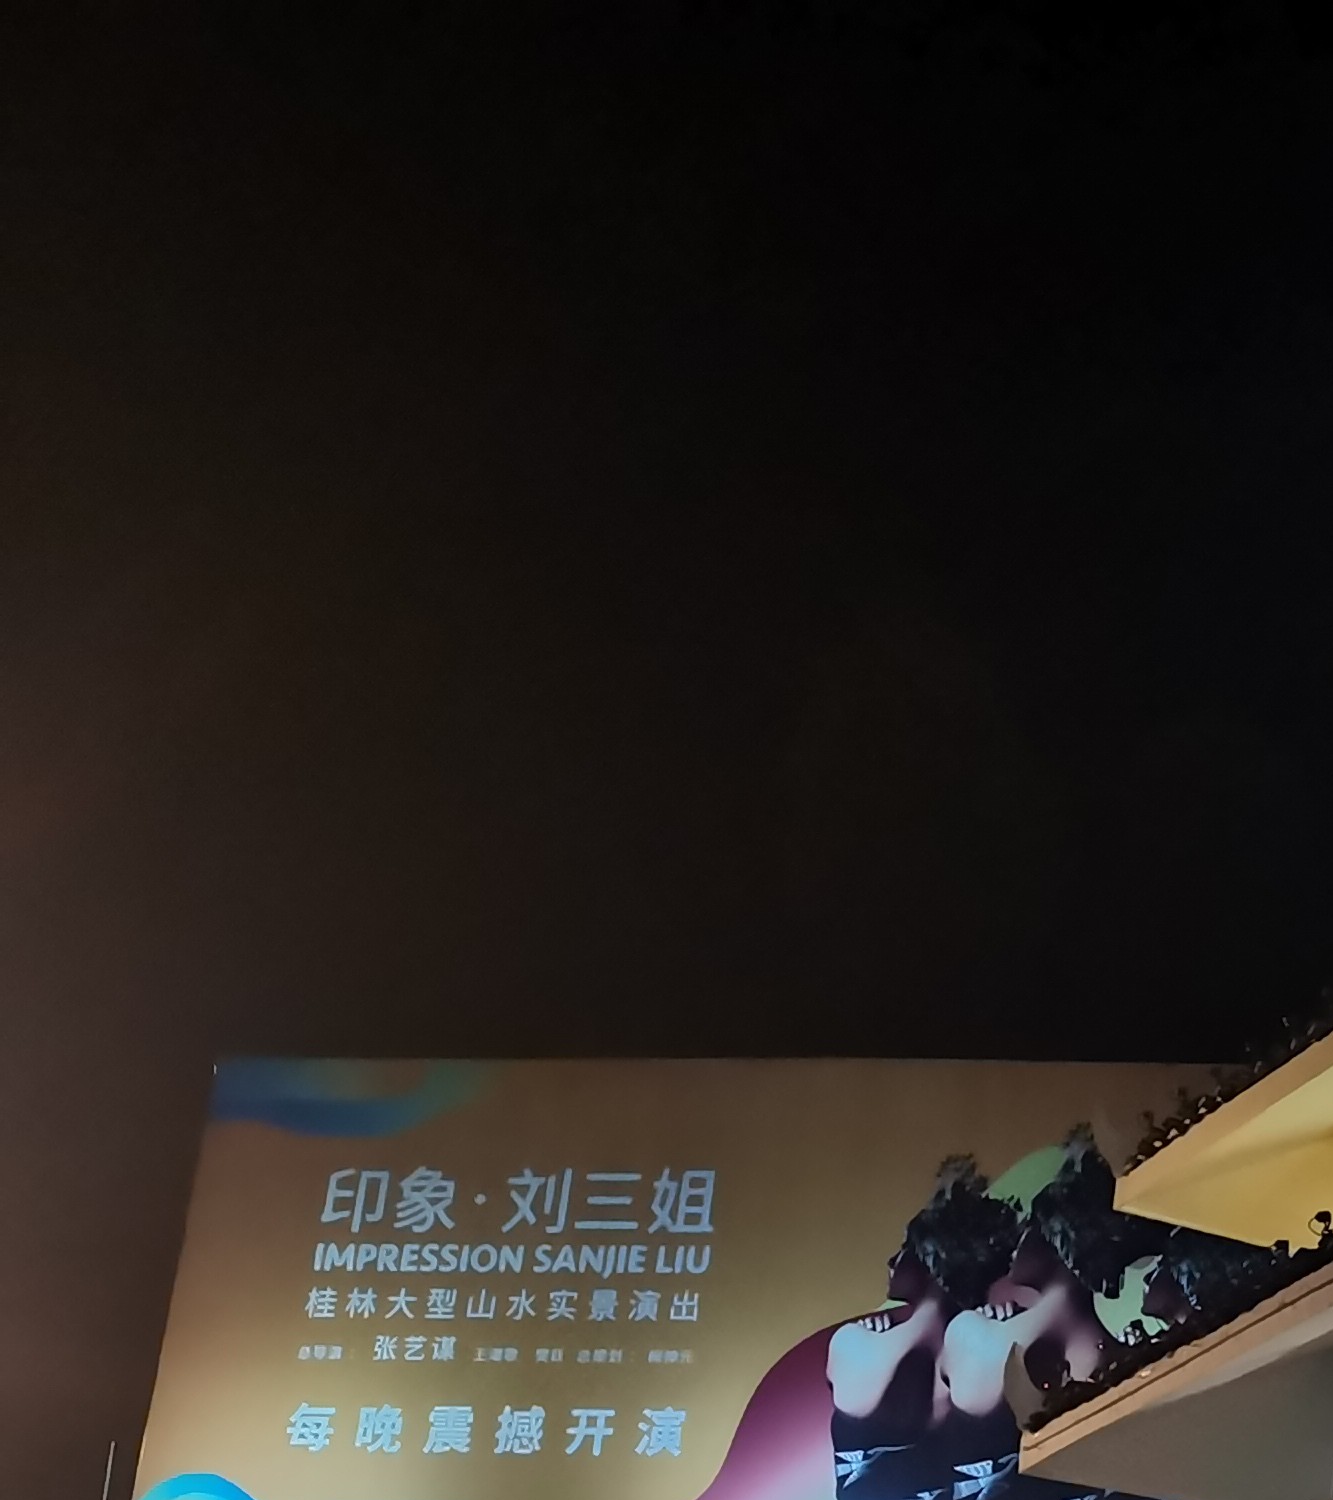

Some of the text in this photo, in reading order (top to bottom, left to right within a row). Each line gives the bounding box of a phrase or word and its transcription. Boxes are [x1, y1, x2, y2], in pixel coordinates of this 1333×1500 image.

[320, 1166, 716, 1234] 印象·刘三姐
[313, 1242, 712, 1280] IMPRESSION SANJIE LIU
[304, 1286, 700, 1322] 桂林大型山水实景演出
[286, 1403, 687, 1457] 每晚震撼开演
